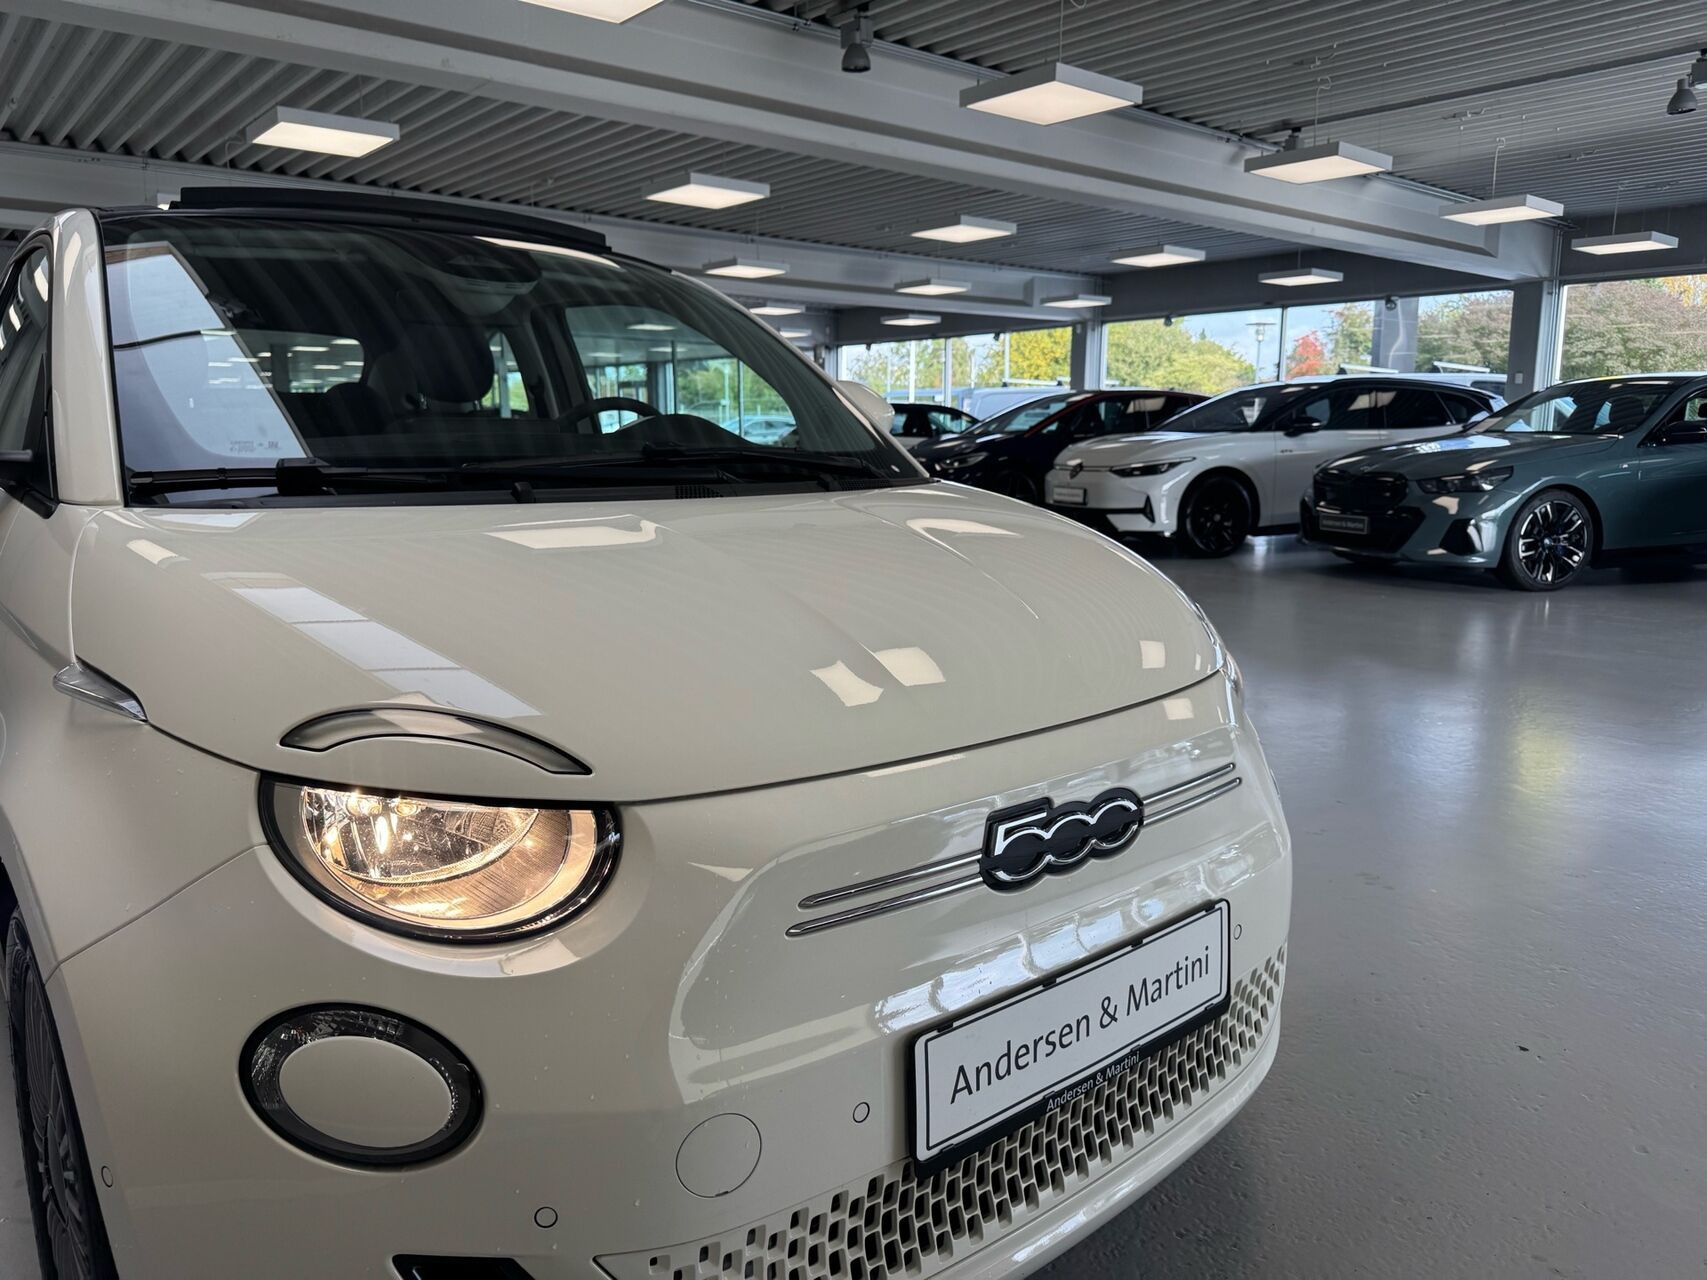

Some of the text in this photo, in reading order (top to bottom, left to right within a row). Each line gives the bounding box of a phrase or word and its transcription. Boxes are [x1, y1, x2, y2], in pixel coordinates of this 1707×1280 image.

[988, 798, 1140, 883] 500
[950, 945, 1210, 1105] Andersen & Martini
[1046, 1050, 1140, 1112] Andersen & Martini
